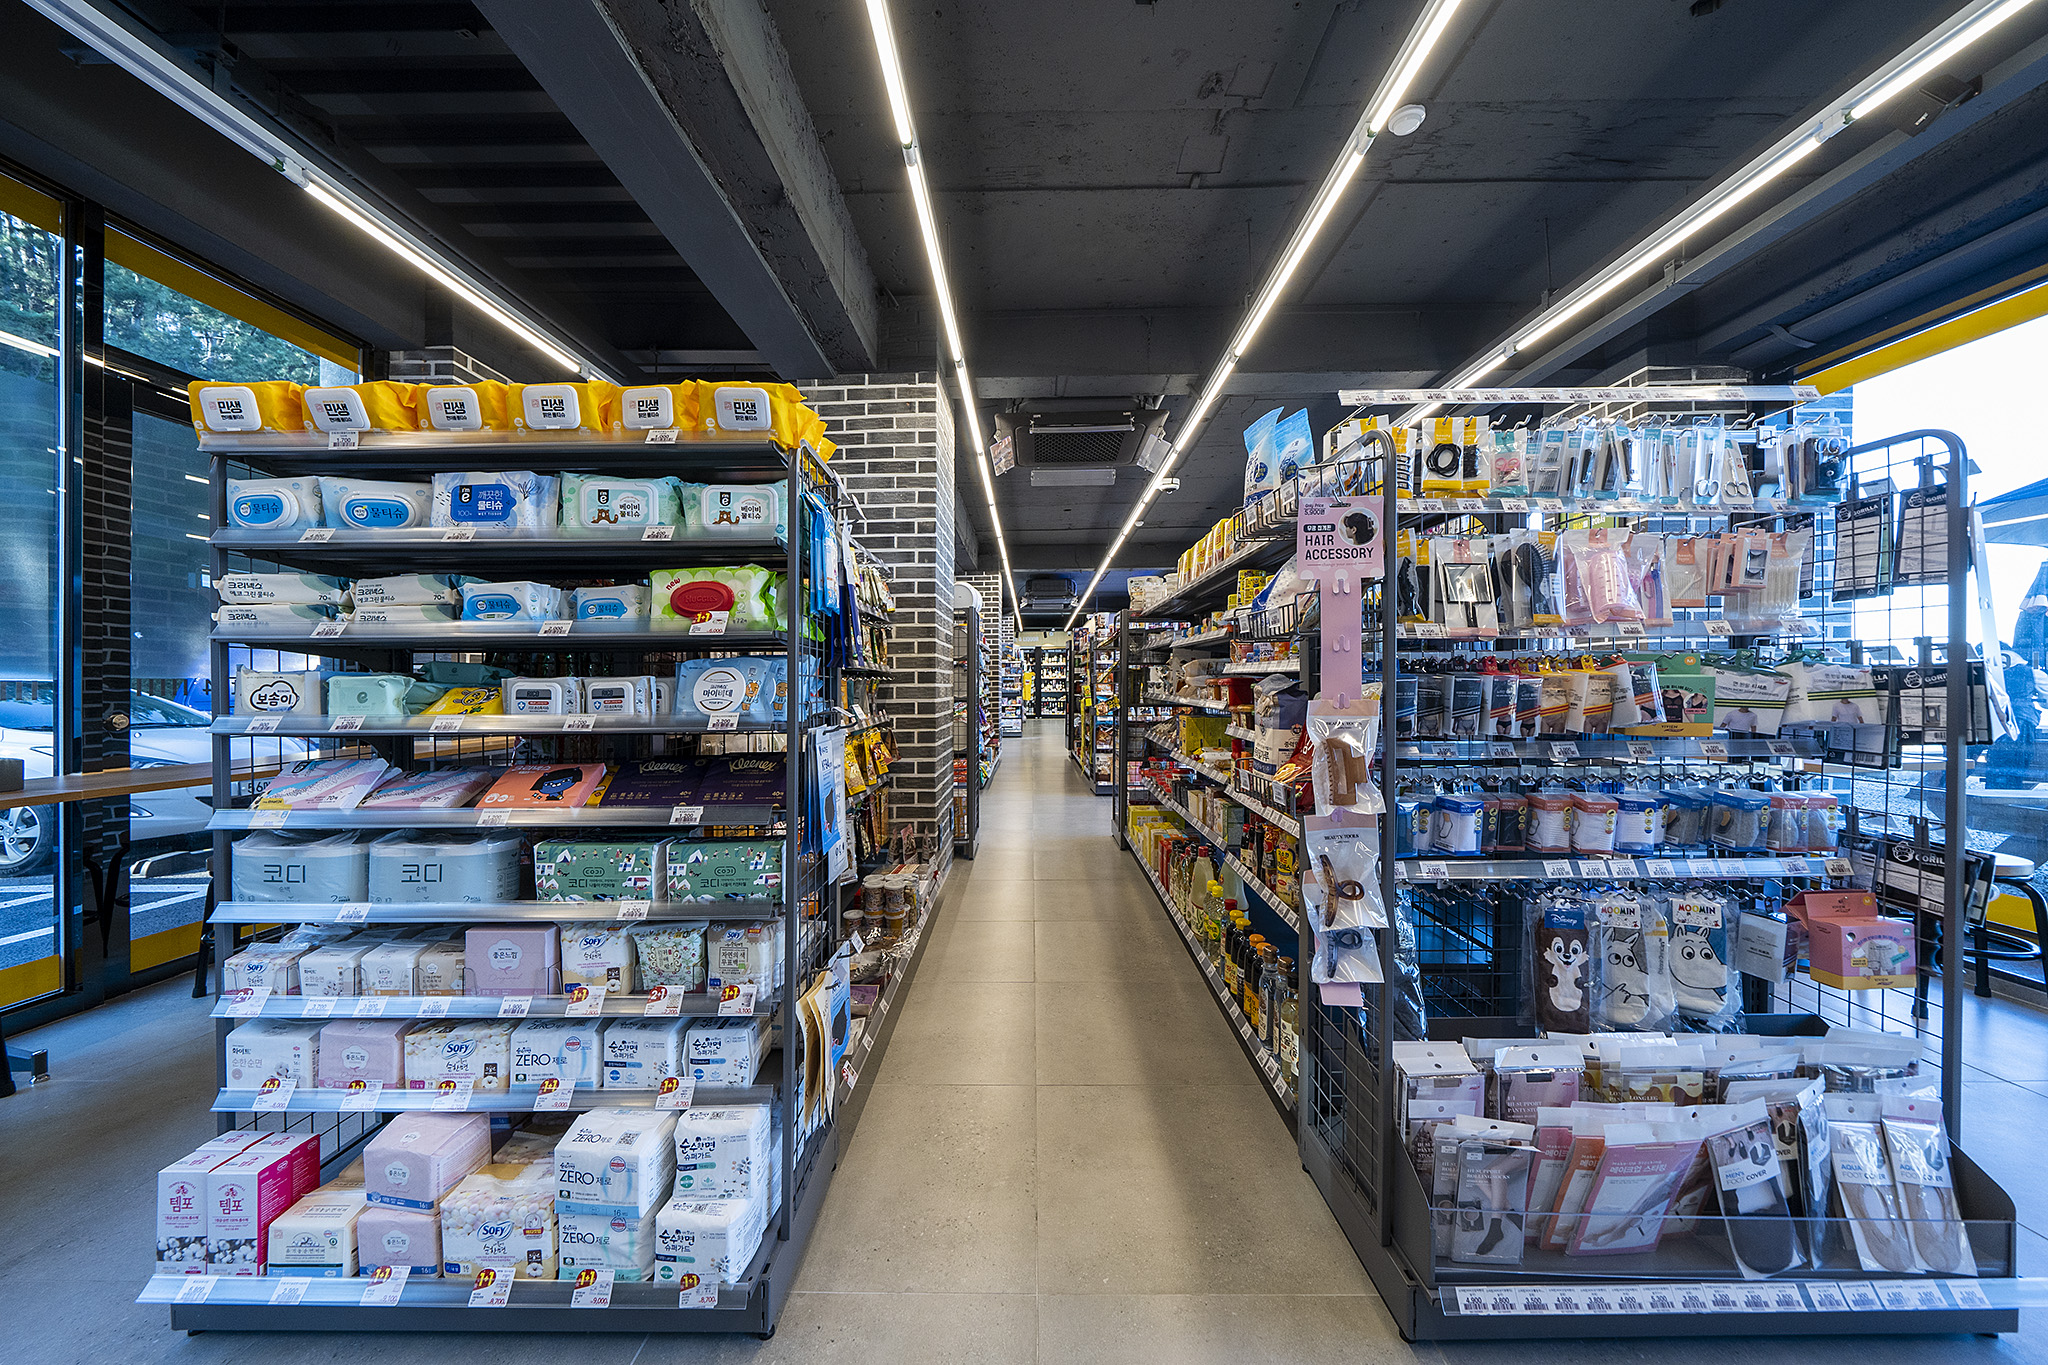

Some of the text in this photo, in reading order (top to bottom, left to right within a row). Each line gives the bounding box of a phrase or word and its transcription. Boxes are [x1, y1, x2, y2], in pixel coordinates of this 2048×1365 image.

[217, 401, 243, 414] 민생
[324, 403, 349, 417] 민생
[443, 402, 467, 415] 민생
[541, 399, 565, 412] 민생
[637, 399, 659, 412] 민생
[733, 401, 757, 415] 민생
[478, 490, 503, 500] 깨끗한
[252, 502, 280, 514] 물티슈
[477, 501, 504, 511] 물티슈
[619, 503, 640, 511] 베이비
[741, 505, 761, 513] 베이비
[1852, 503, 1879, 516] GORILLA
[370, 507, 404, 519] 물티슈
[1305, 535, 1334, 546] HAIR
[1305, 547, 1374, 560] ACCESSORY
[228, 582, 263, 590] 크리넥스
[665, 577, 681, 591] new
[357, 588, 385, 596] 크리넥스
[487, 600, 511, 610] 물티슈
[227, 613, 257, 621] 크리넥스
[695, 612, 711, 623] 1+1
[256, 691, 293, 707] 보송이
[702, 689, 734, 698] 마이비데
[639, 761, 687, 774] Kleenex
[729, 757, 778, 772] Kleenex
[263, 864, 306, 884] 코디
[401, 863, 442, 883] 코디
[568, 879, 588, 888] 코디
[700, 878, 719, 888] 코디
[1601, 906, 1636, 915] MOOMIN
[1678, 903, 1716, 915] MOOMIN
[1551, 914, 1578, 925] Disney
[583, 937, 601, 946] SOFY
[493, 951, 518, 960] 좋은느낌
[246, 963, 263, 971] SOFY
[236, 990, 252, 1001] 2+1
[572, 989, 588, 1002] 1+1
[650, 988, 665, 1001] 2+1
[724, 987, 738, 999] 1+1
[446, 1043, 469, 1054] SOFY
[608, 1040, 639, 1053] 순수한면
[692, 1037, 722, 1050] 순수한면
[232, 1058, 263, 1069] 순한순면
[515, 1053, 568, 1066] ZERO 제로
[264, 1080, 279, 1093] 1+1
[350, 1081, 366, 1093] 1+1
[440, 1082, 455, 1095] 1+1
[543, 1080, 557, 1092] 1+1
[663, 1079, 677, 1092] 1+1
[572, 1133, 602, 1144] ZERO
[679, 1136, 716, 1154] 순수한면
[684, 1152, 712, 1161] 슈퍼가드
[1609, 1164, 1667, 1173] 메이크업 스타킹
[1841, 1163, 1862, 1171] AQUA
[388, 1170, 407, 1178] 좋은느낌
[559, 1169, 613, 1186] ZERO 제로
[1725, 1169, 1768, 1185] FOOT COVER
[1842, 1171, 1864, 1180] FOOT
[169, 1195, 194, 1213] 템포
[219, 1198, 244, 1215] 템포
[482, 1225, 506, 1237] SOFY
[659, 1229, 696, 1245] 순수한면
[562, 1231, 611, 1245] ZERO 제로
[374, 1268, 391, 1283] 1+1
[478, 1272, 495, 1287] 1+1
[579, 1271, 596, 1286] 1+1
[682, 1275, 699, 1288] 1+1
